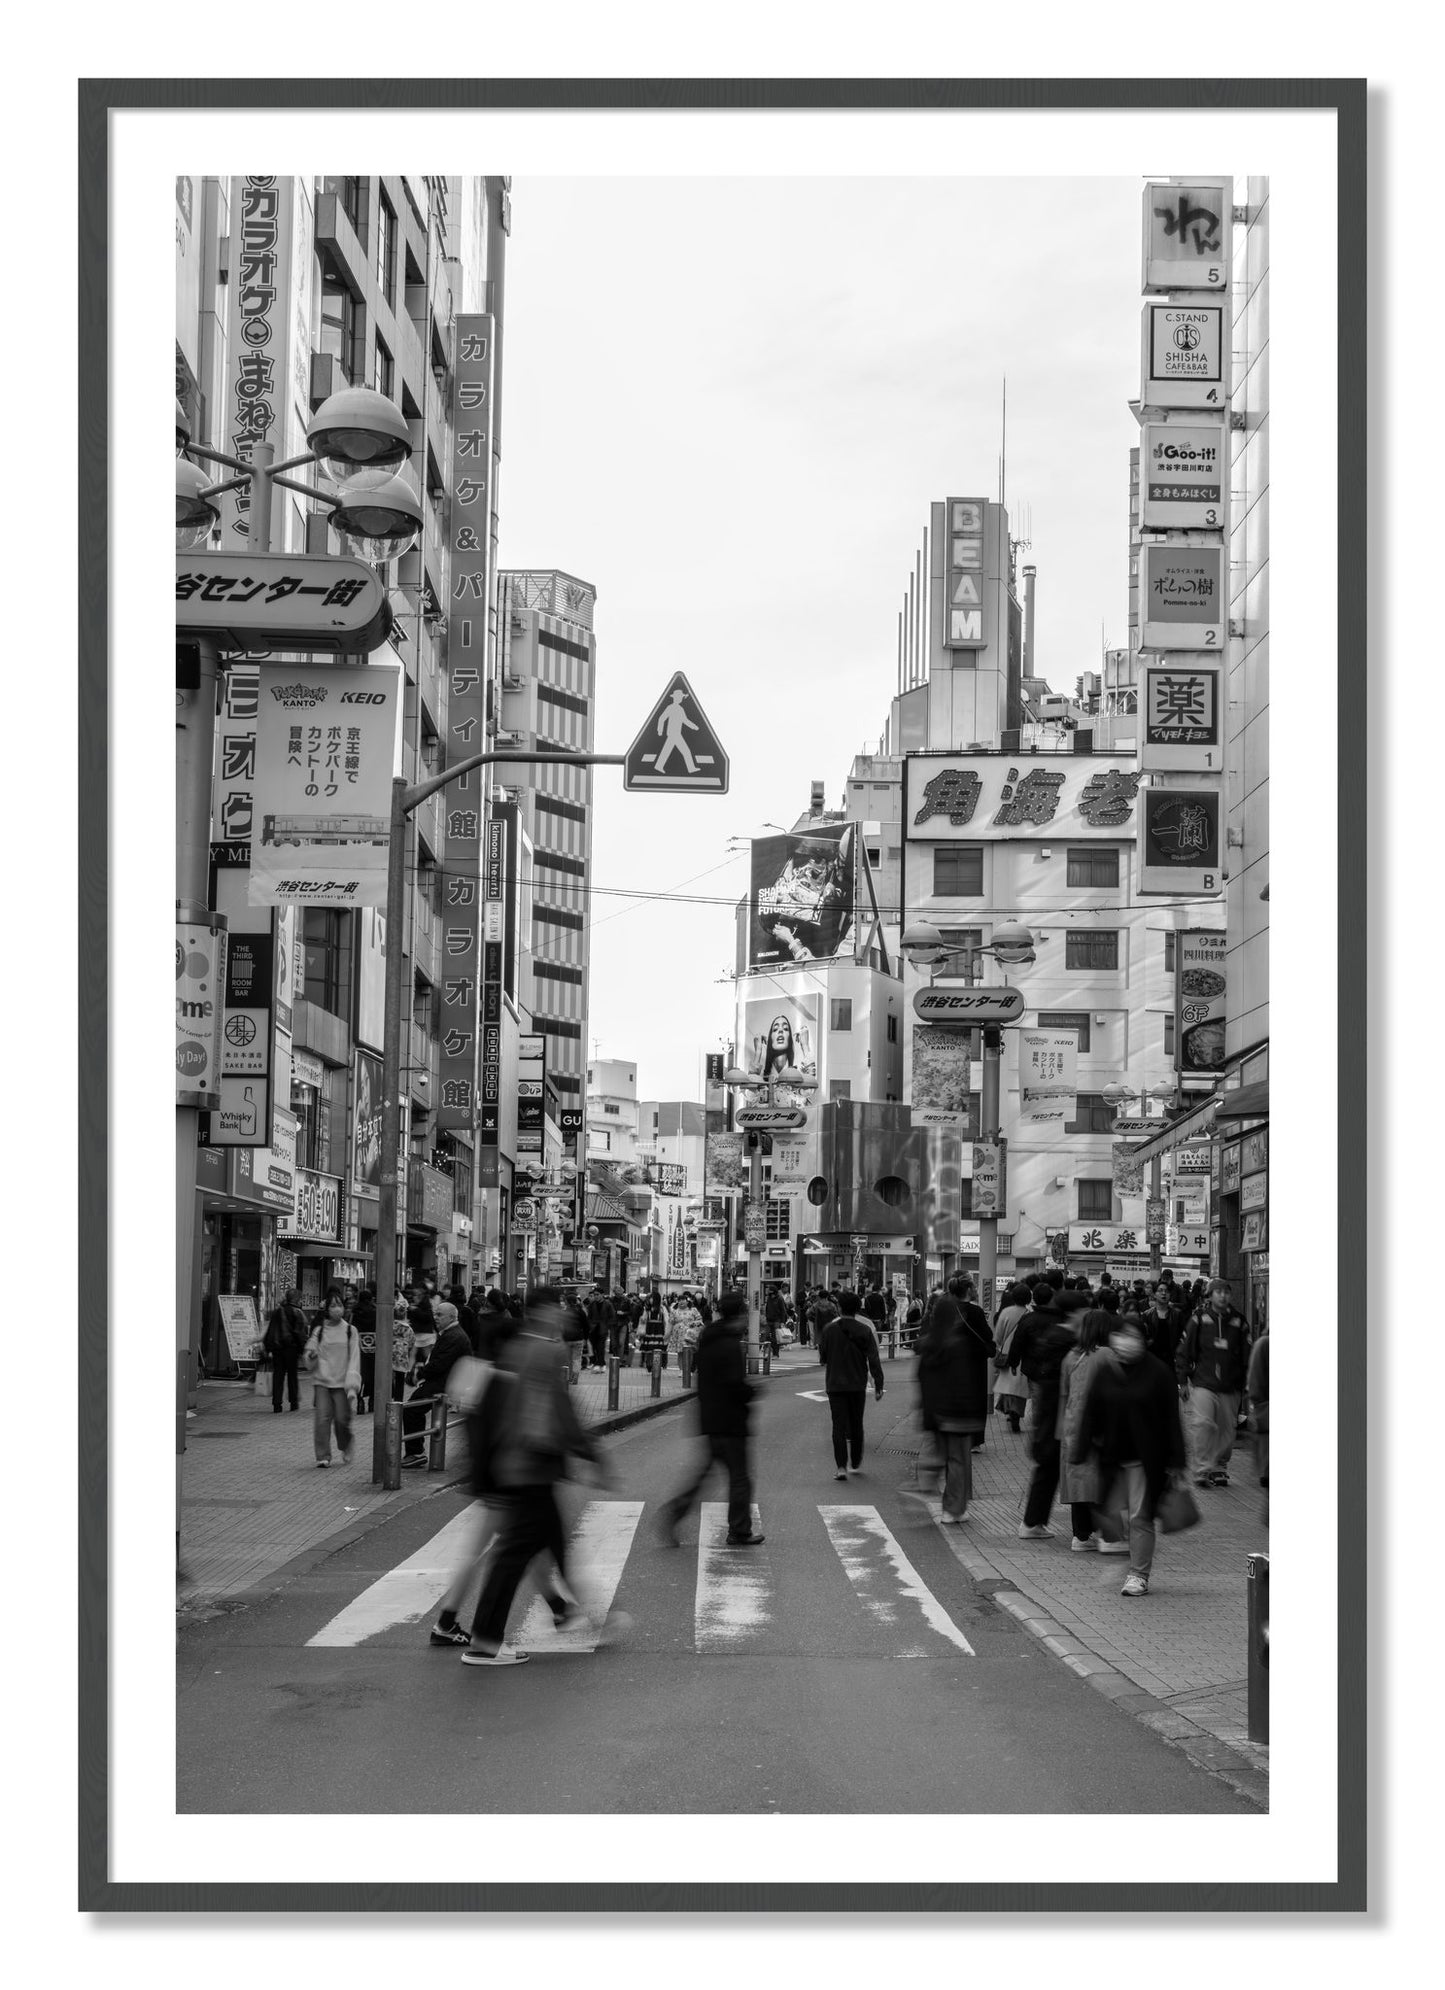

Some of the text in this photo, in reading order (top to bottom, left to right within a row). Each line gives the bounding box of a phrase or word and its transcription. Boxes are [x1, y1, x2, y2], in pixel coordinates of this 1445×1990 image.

[239, 187, 279, 319] カラオケ
[1207, 267, 1220, 283] 5
[1165, 313, 1209, 322] C.STAND
[1165, 352, 1208, 362] SHISHA
[1165, 362, 1208, 371] CAFE&BAR
[1157, 463, 1213, 473] 渋谷宇田川町店
[1152, 487, 1217, 499] 全身もみほぐし
[1205, 509, 1217, 525] 3
[951, 503, 983, 640] BEAM
[1205, 630, 1217, 645] 2
[341, 692, 387, 705] KEIO
[1157, 676, 1205, 725] 薬
[1151, 728, 1210, 741] マツモトキヨシ
[287, 726, 303, 767] 冒険へ
[305, 726, 322, 797] カントーの
[324, 726, 342, 797] ポケパーク
[345, 727, 361, 784] 京王線で
[1204, 752, 1213, 767] 1
[914, 768, 1143, 826] 角海老
[490, 824, 500, 896] kimono hearts
[1203, 874, 1215, 889] B
[236, 945, 250, 953] THE
[920, 995, 1018, 1008] 渋谷センター街
[1182, 1004, 1210, 1024] 6F
[220, 1112, 252, 1122] Whisky
[562, 1115, 582, 1126] GU
[220, 1121, 239, 1129] Bank
